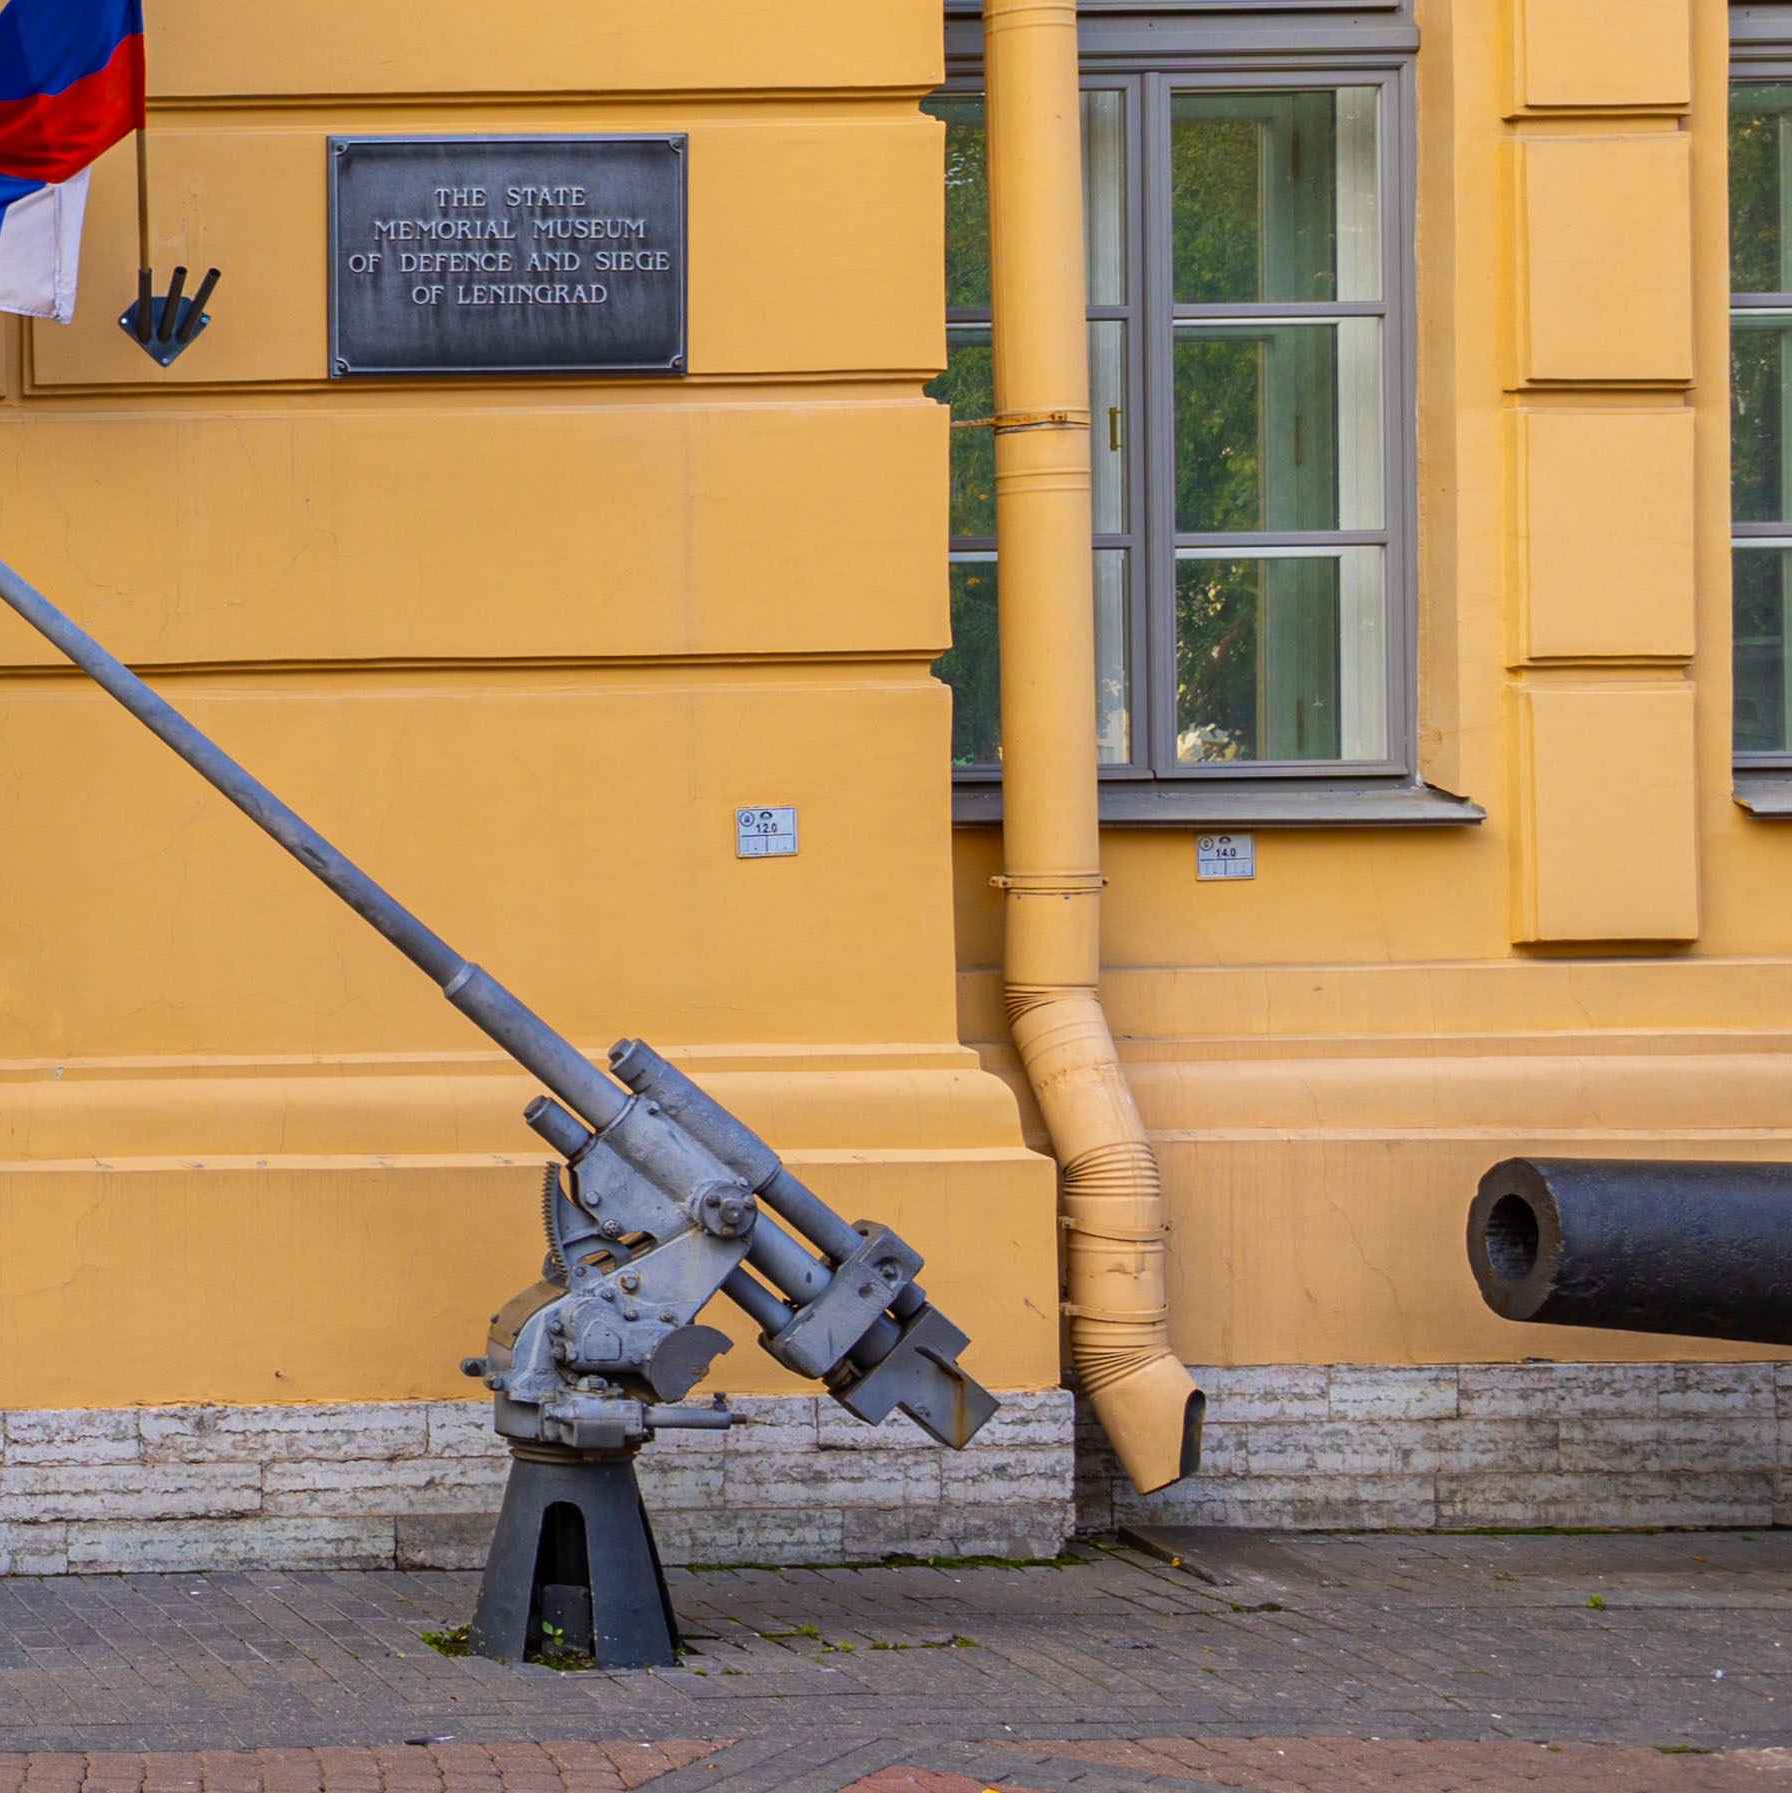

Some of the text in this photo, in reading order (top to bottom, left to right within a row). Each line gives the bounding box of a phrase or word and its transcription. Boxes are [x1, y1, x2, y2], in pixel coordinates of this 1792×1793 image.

[434, 187, 587, 207] THE STATE
[373, 219, 646, 241] MEMORIAL MUSEUM
[348, 251, 671, 274] OF DEFENCE AND SIEGE
[411, 284, 608, 306] OF LENINGRAD
